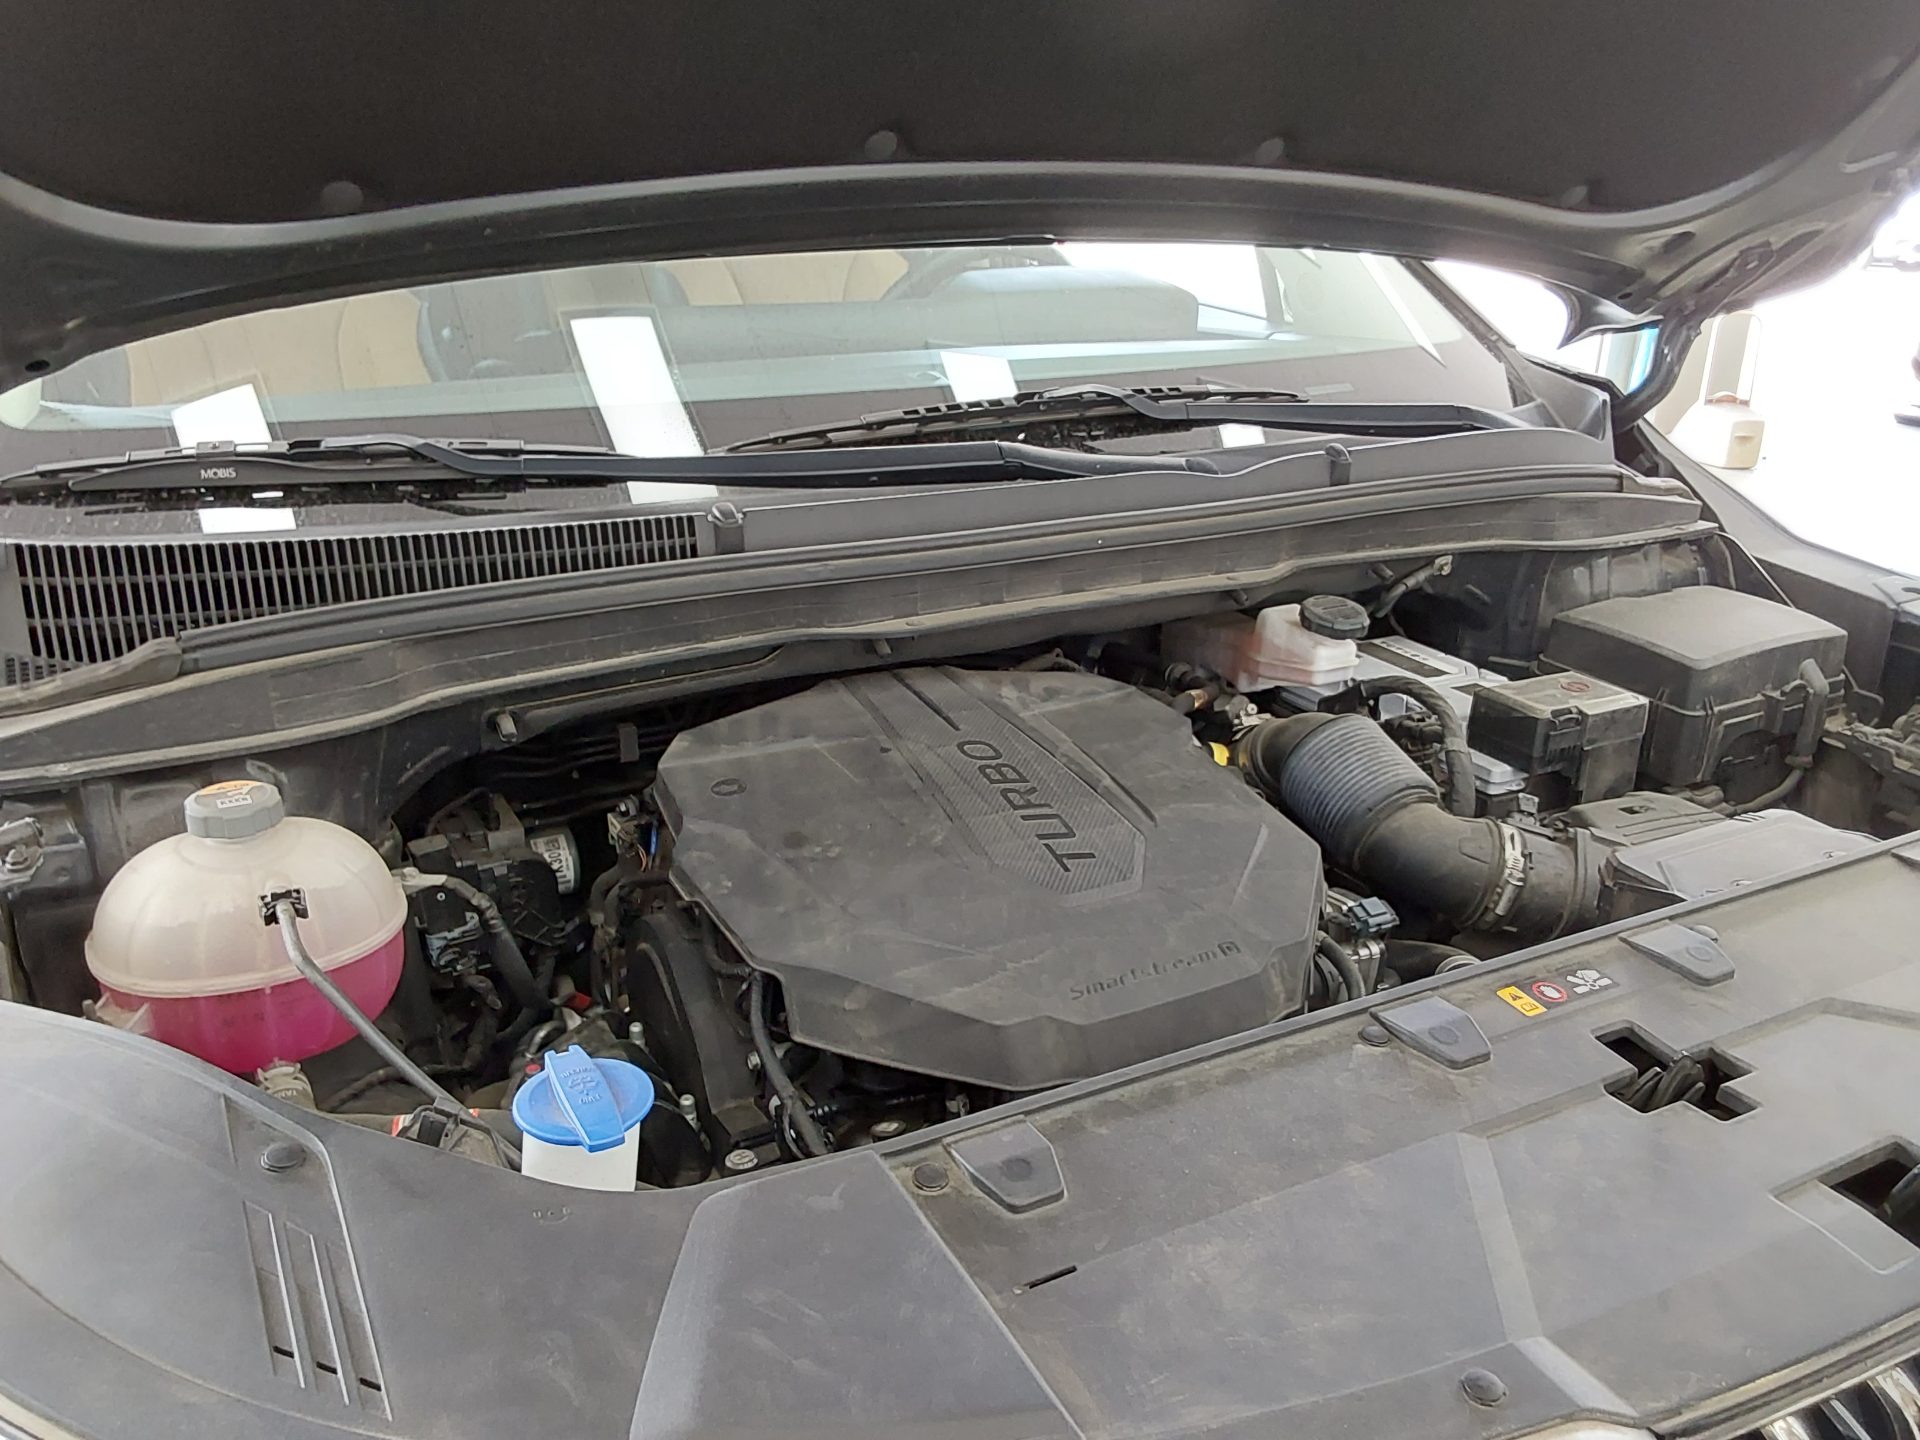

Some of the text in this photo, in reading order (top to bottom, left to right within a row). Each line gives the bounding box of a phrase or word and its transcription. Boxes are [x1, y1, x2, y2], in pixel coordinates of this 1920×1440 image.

[200, 467, 237, 480] MOBIS
[956, 740, 1096, 873] TURBO
[1069, 950, 1218, 1001] Smartstream
